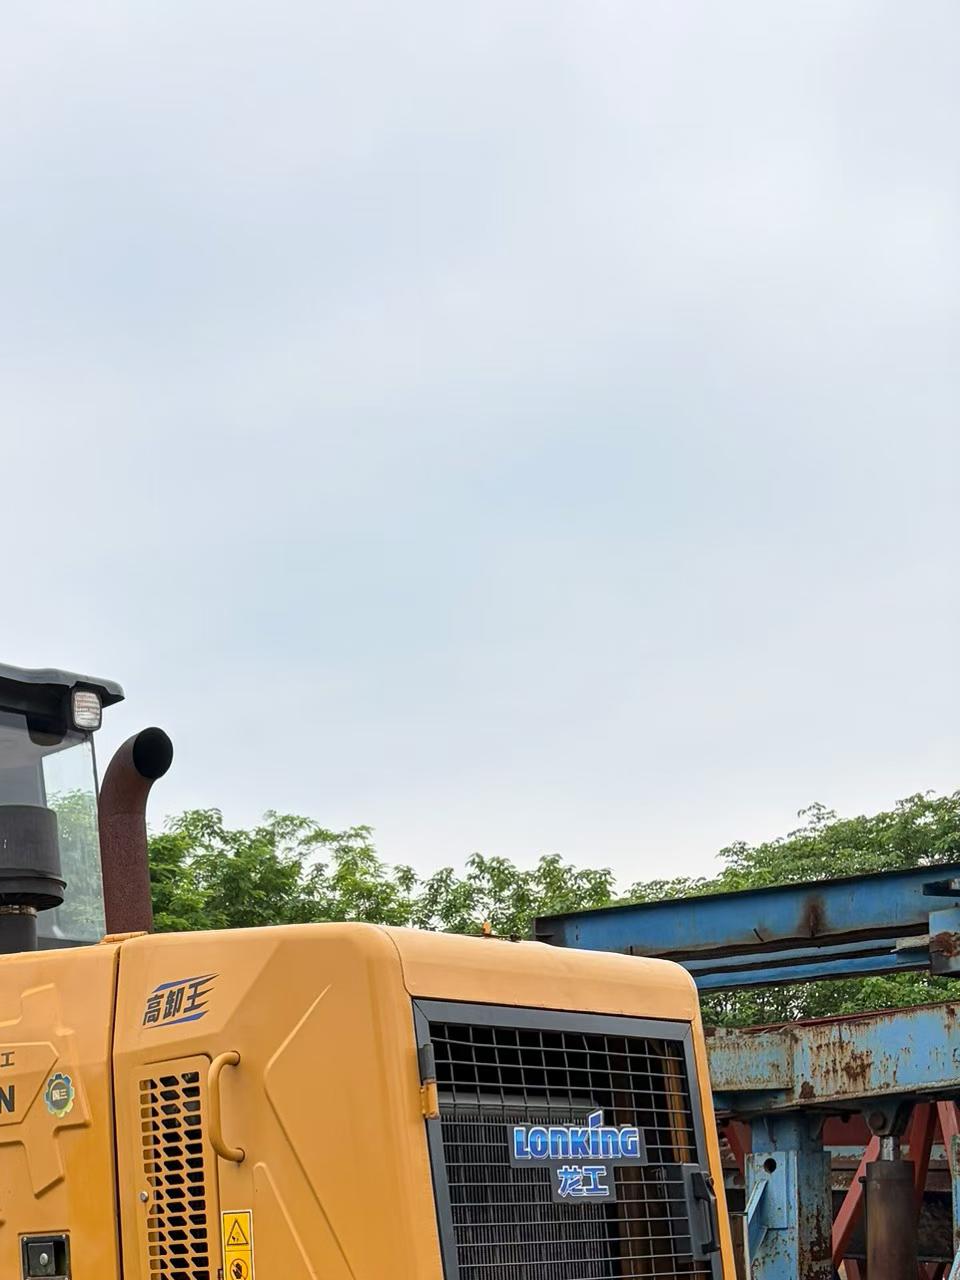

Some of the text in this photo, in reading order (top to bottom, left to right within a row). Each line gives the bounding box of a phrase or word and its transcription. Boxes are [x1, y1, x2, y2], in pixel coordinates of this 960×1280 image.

[142, 974, 219, 1026] 高卸王
[557, 1165, 610, 1197] 龙工
